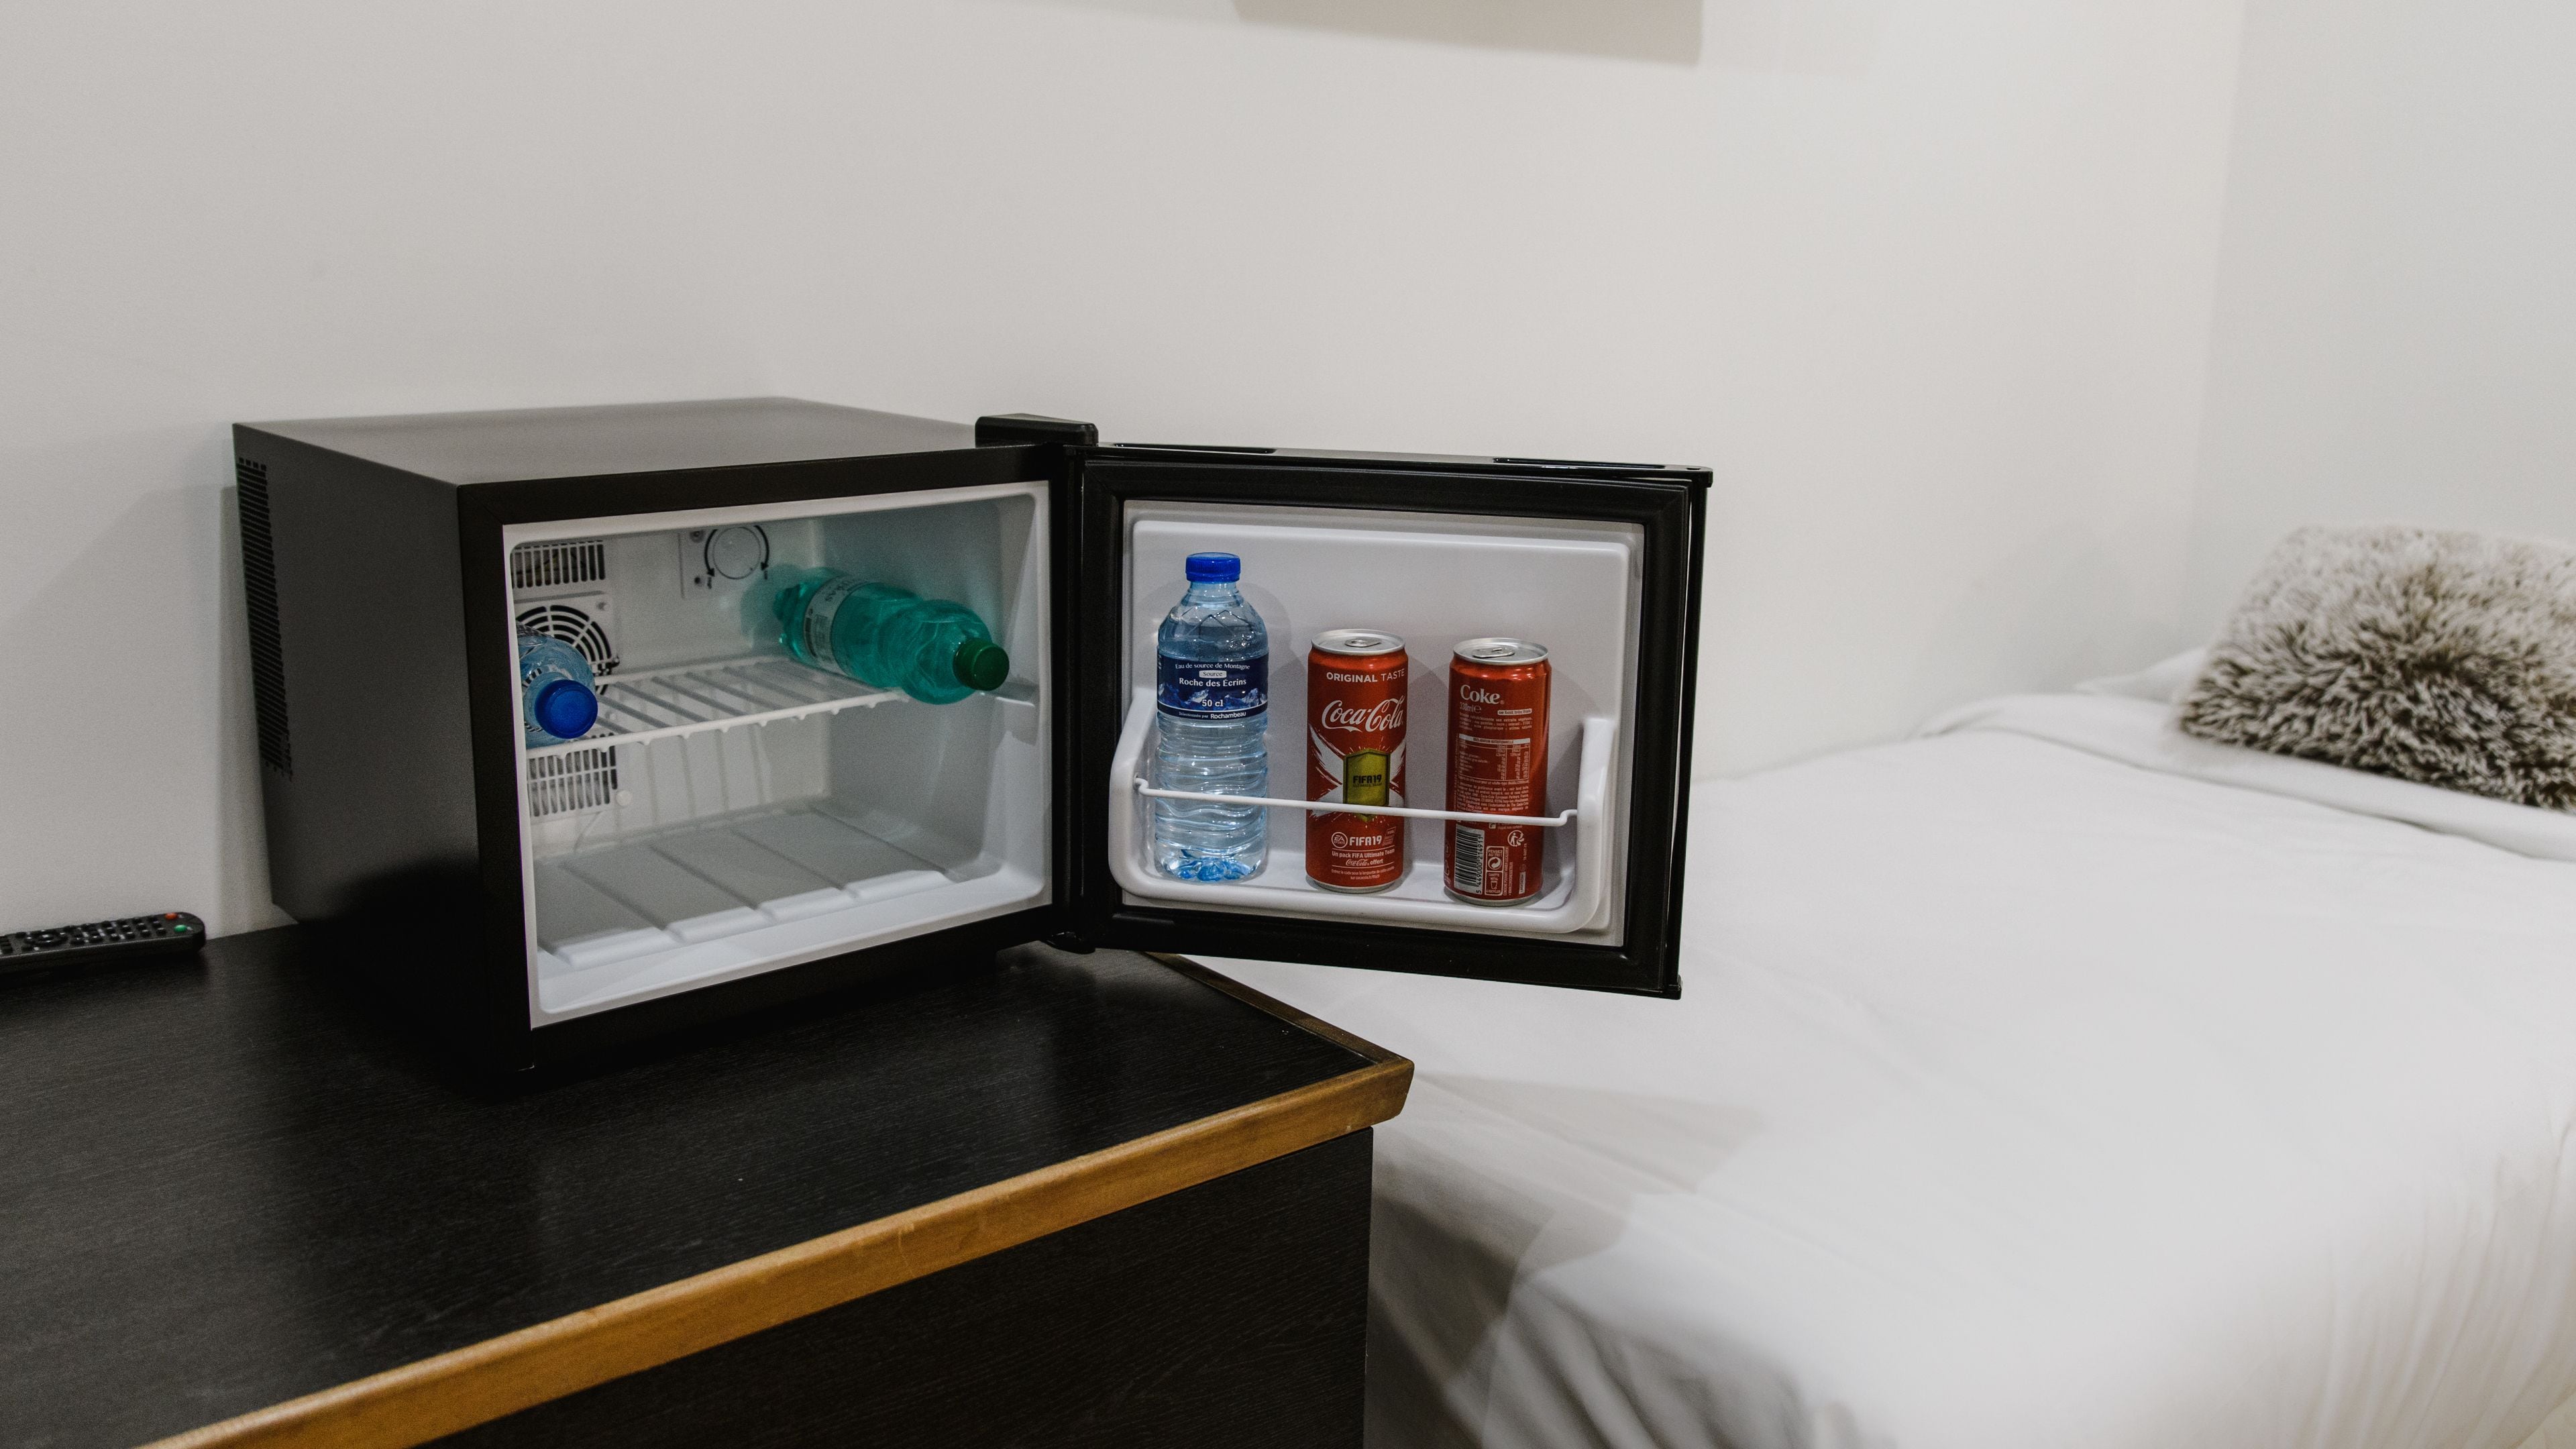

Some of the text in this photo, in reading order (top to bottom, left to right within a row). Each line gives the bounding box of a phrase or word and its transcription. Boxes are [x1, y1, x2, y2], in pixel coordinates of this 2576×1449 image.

[1326, 668, 1405, 683] ORIGINAL TASTE
[1179, 678, 1203, 686] Roche
[1205, 679, 1220, 687] des
[1460, 684, 1501, 704] Coke
[1201, 699, 1224, 707] 50 cl
[1210, 711, 1246, 719] Rochambeau
[1321, 694, 1405, 733] Coca-Cola
[1364, 851, 1385, 859] Ultimate
